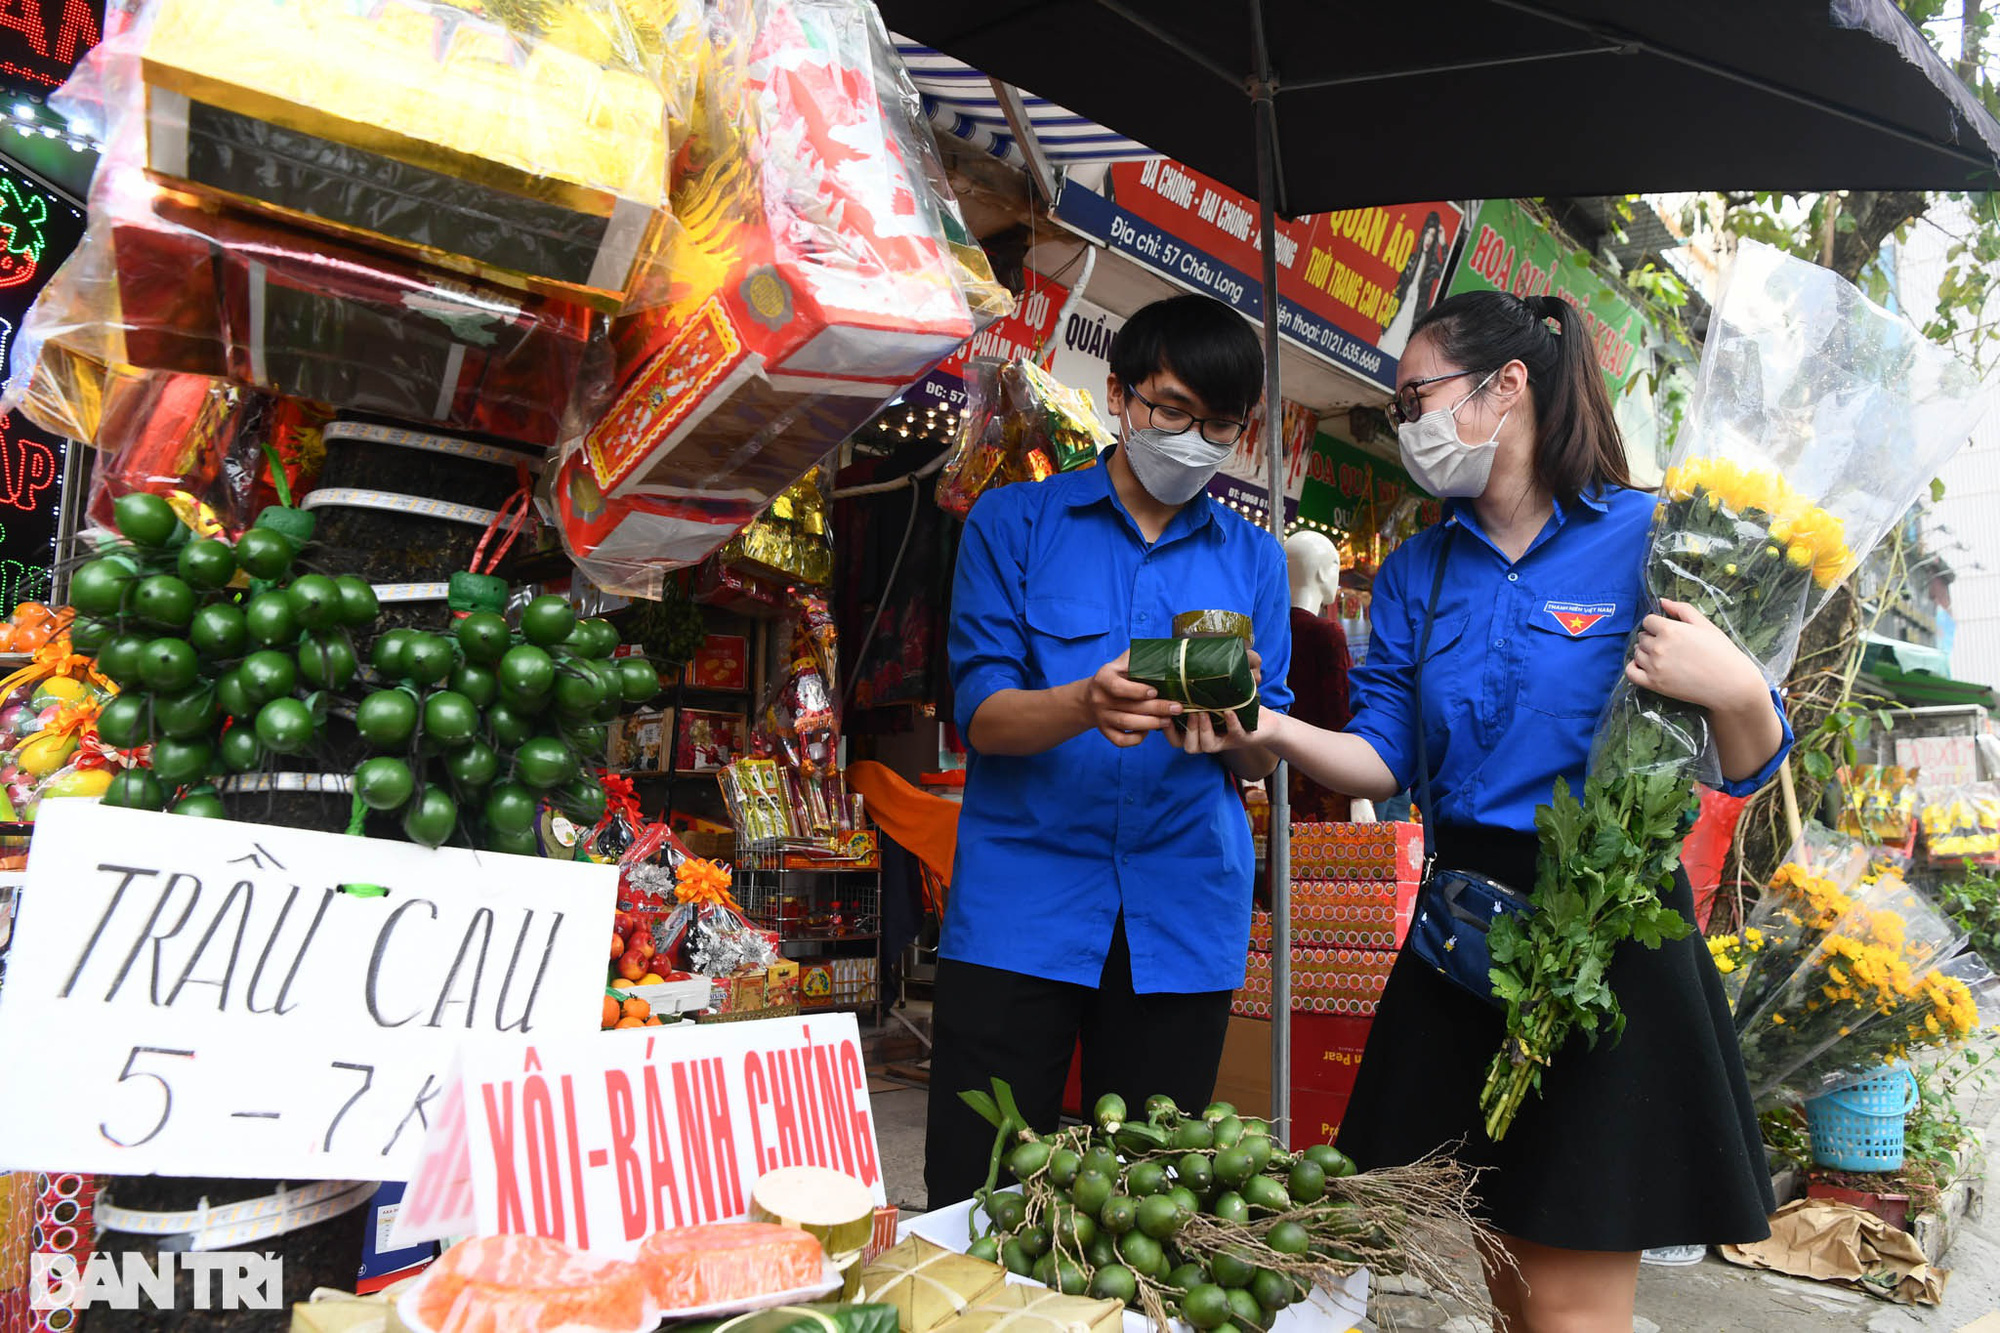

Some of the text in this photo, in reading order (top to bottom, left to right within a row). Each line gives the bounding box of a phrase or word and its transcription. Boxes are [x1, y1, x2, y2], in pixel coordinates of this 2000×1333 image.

[1198, 189, 1221, 224] HAI
[1110, 216, 1244, 304] Địa chỉ: 57 Châu Long
[1382, 212, 1415, 273] ÁO
[1469, 224, 1515, 292] HOA
[1304, 245, 1333, 290] THỜI
[1327, 260, 1363, 309] TRANG
[1357, 281, 1382, 320] CAO
[1320, 329, 1381, 374] 0121.635.6668
[925, 381, 966, 404] ĐC: 57
[57, 842, 565, 1033] TRẦU CAU
[1323, 1051, 1351, 1065] Pear
